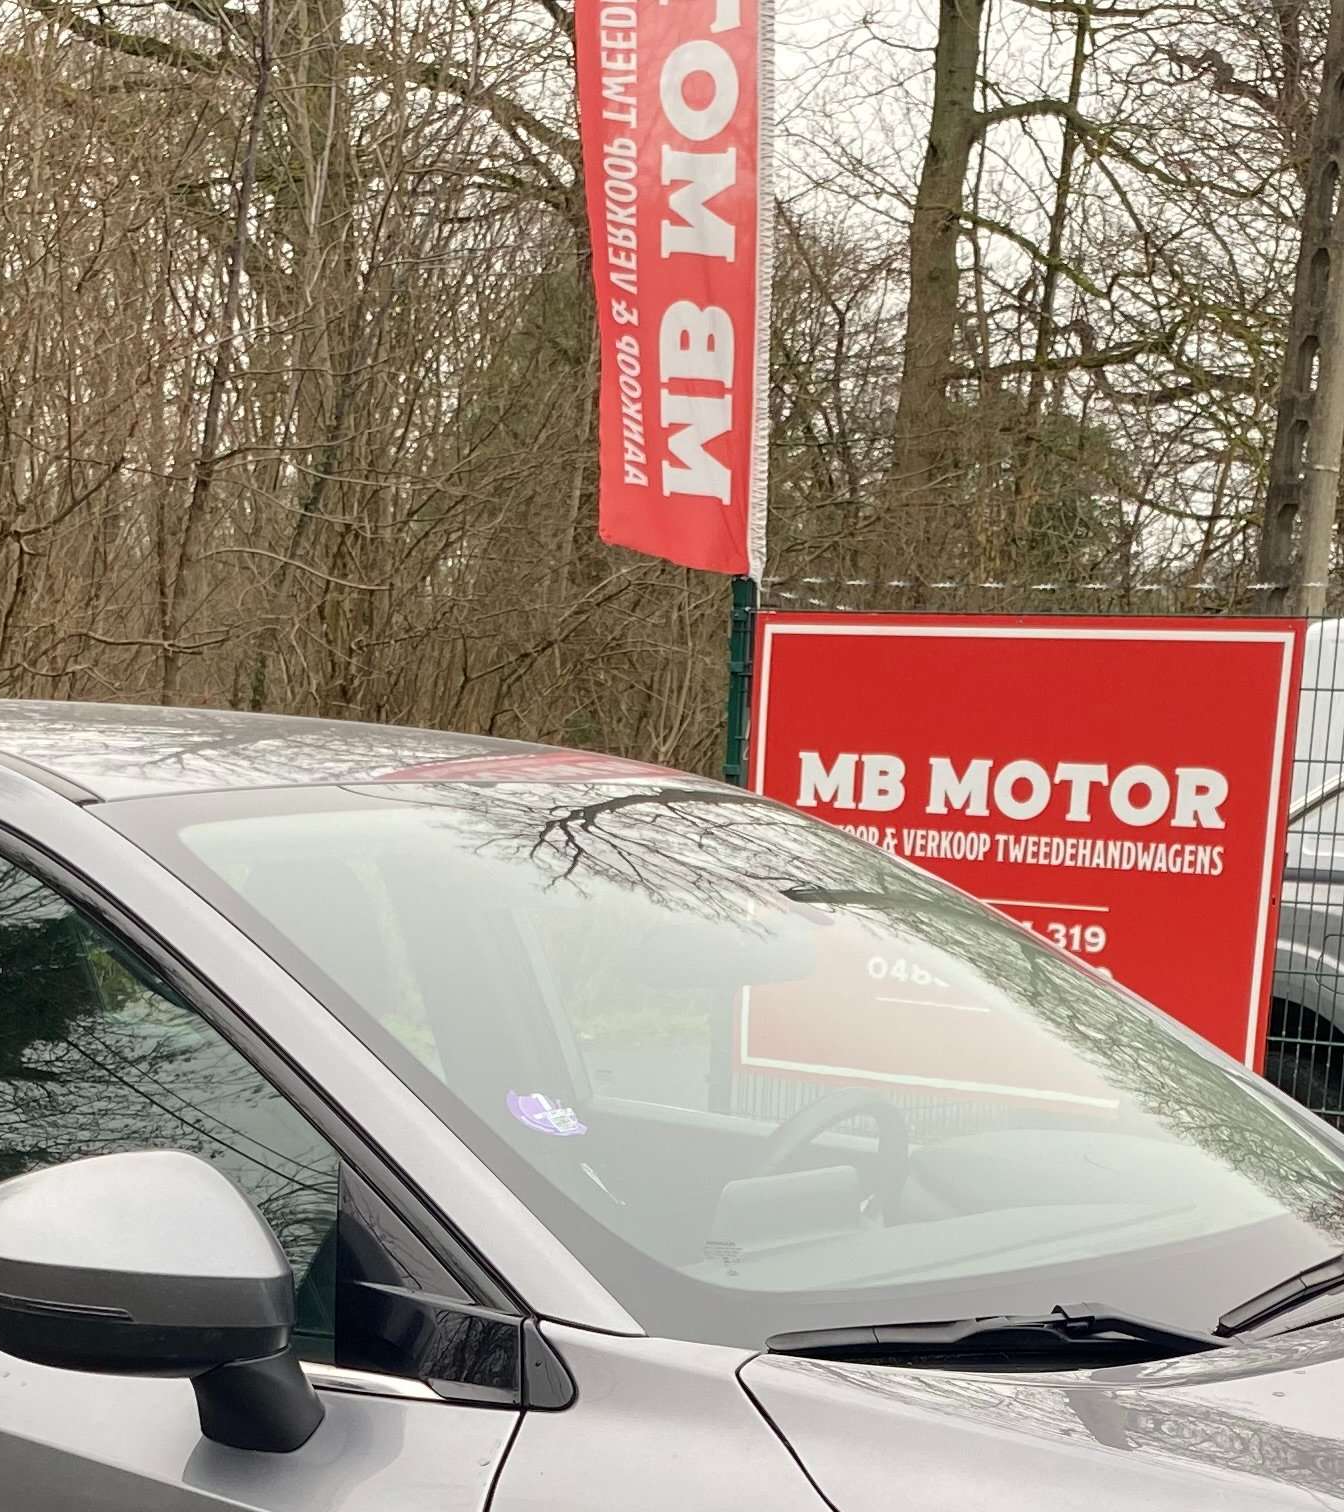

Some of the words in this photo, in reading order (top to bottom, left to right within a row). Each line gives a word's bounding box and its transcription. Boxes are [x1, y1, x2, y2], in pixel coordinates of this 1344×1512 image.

[796, 752, 905, 812] MB
[926, 757, 1229, 830] MOTOR
[902, 828, 991, 862] VERKOOP
[994, 834, 1224, 876] TWEEDEHANDWAGENS
